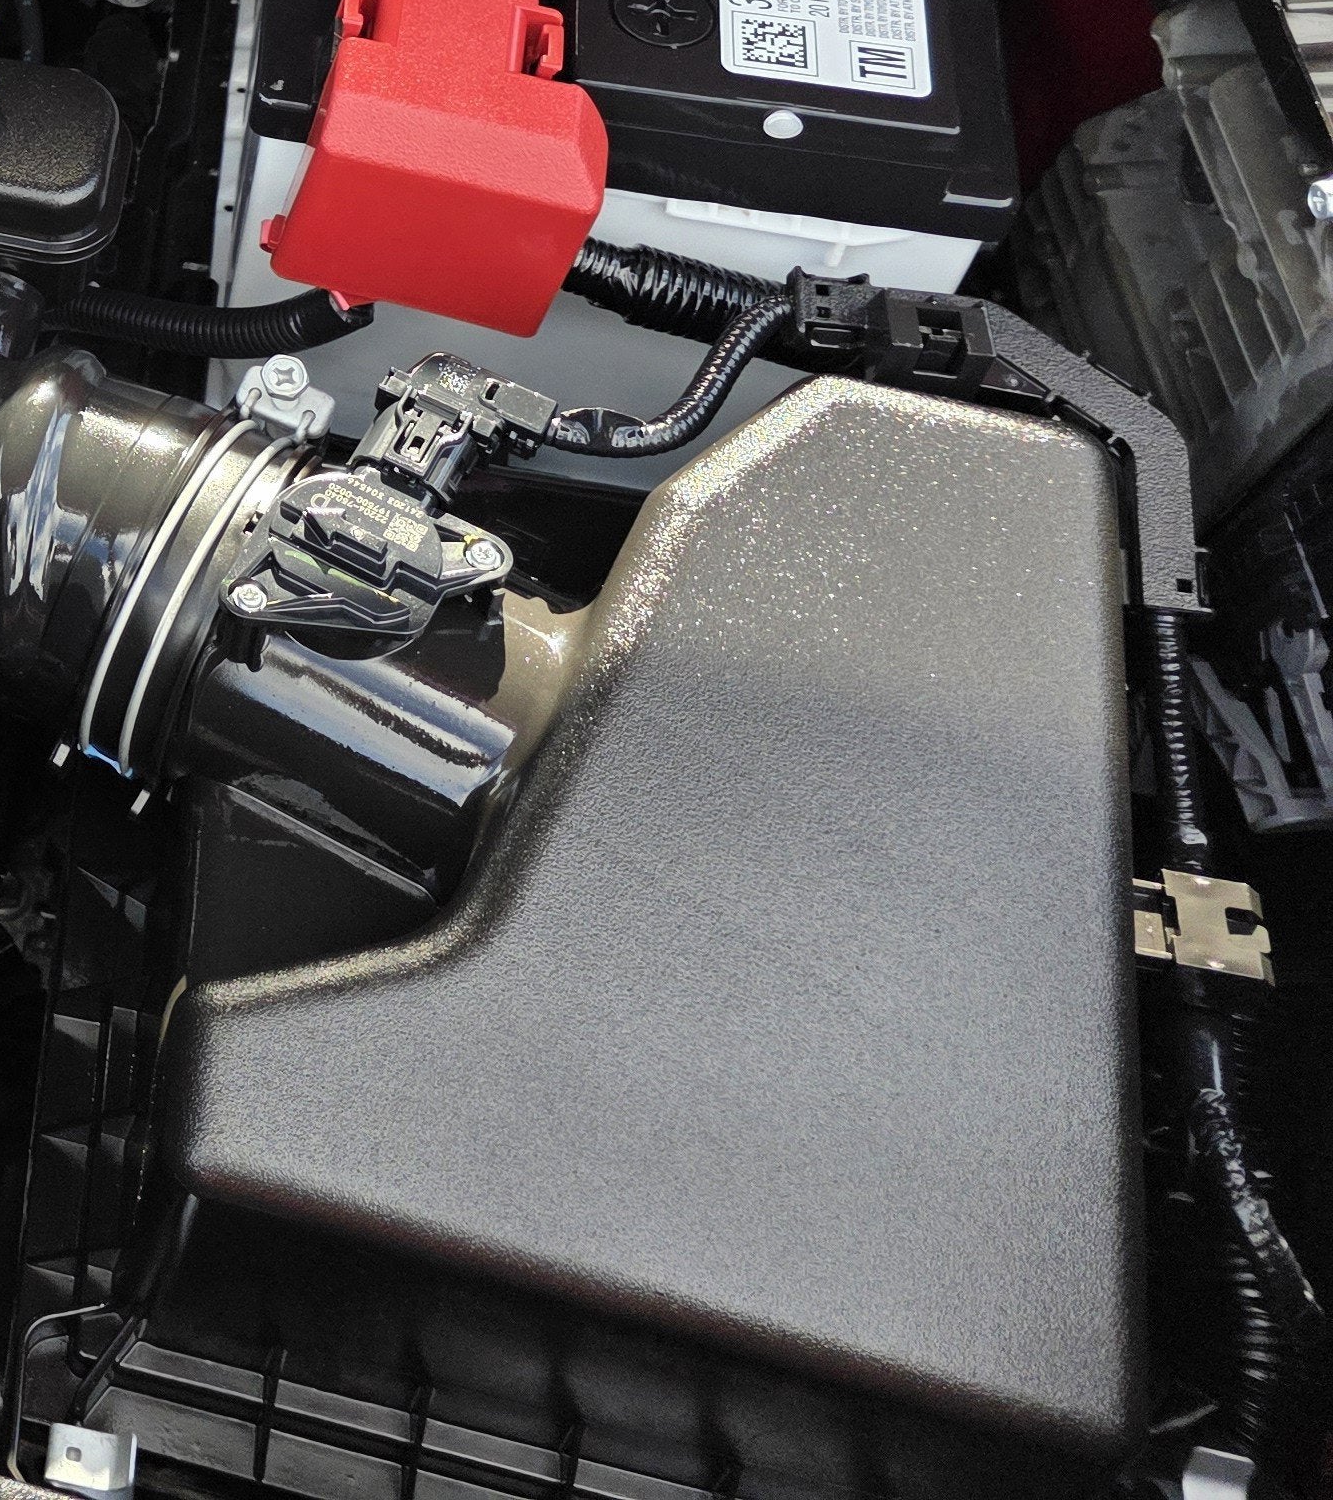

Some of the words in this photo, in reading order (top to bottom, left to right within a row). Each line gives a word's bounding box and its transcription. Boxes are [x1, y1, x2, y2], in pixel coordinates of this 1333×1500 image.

[789, 3, 800, 13] TO
[806, 3, 829, 17] 20
[850, 4, 861, 13] BY
[889, 8, 901, 17] BY
[903, 11, 914, 19] BY
[857, 46, 907, 82] TM
